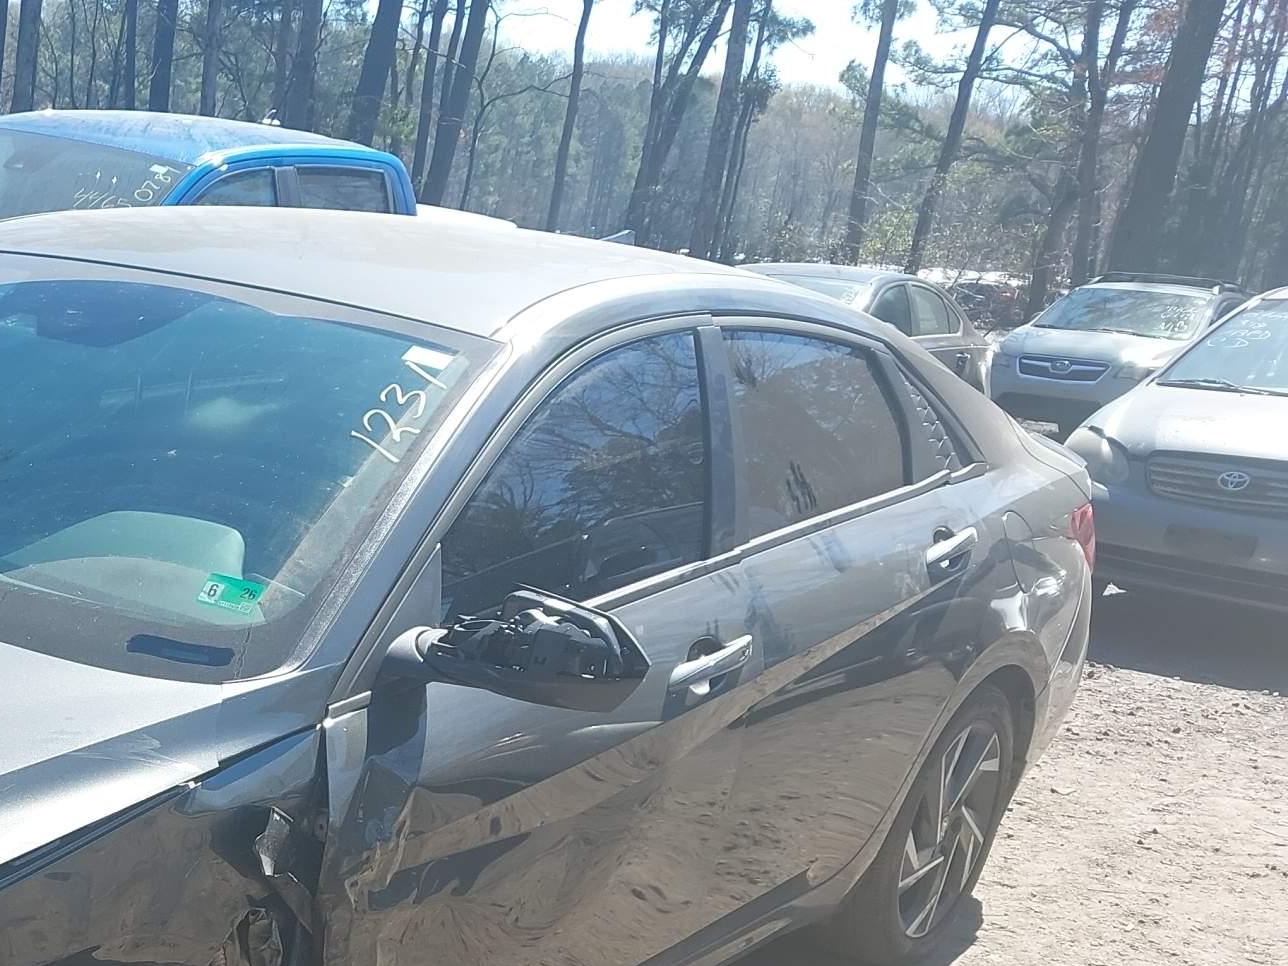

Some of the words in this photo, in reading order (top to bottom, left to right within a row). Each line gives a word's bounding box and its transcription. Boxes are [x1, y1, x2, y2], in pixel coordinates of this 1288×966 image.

[350, 359, 449, 463] 1231
[207, 583, 219, 598] 6
[239, 587, 258, 601] 26
